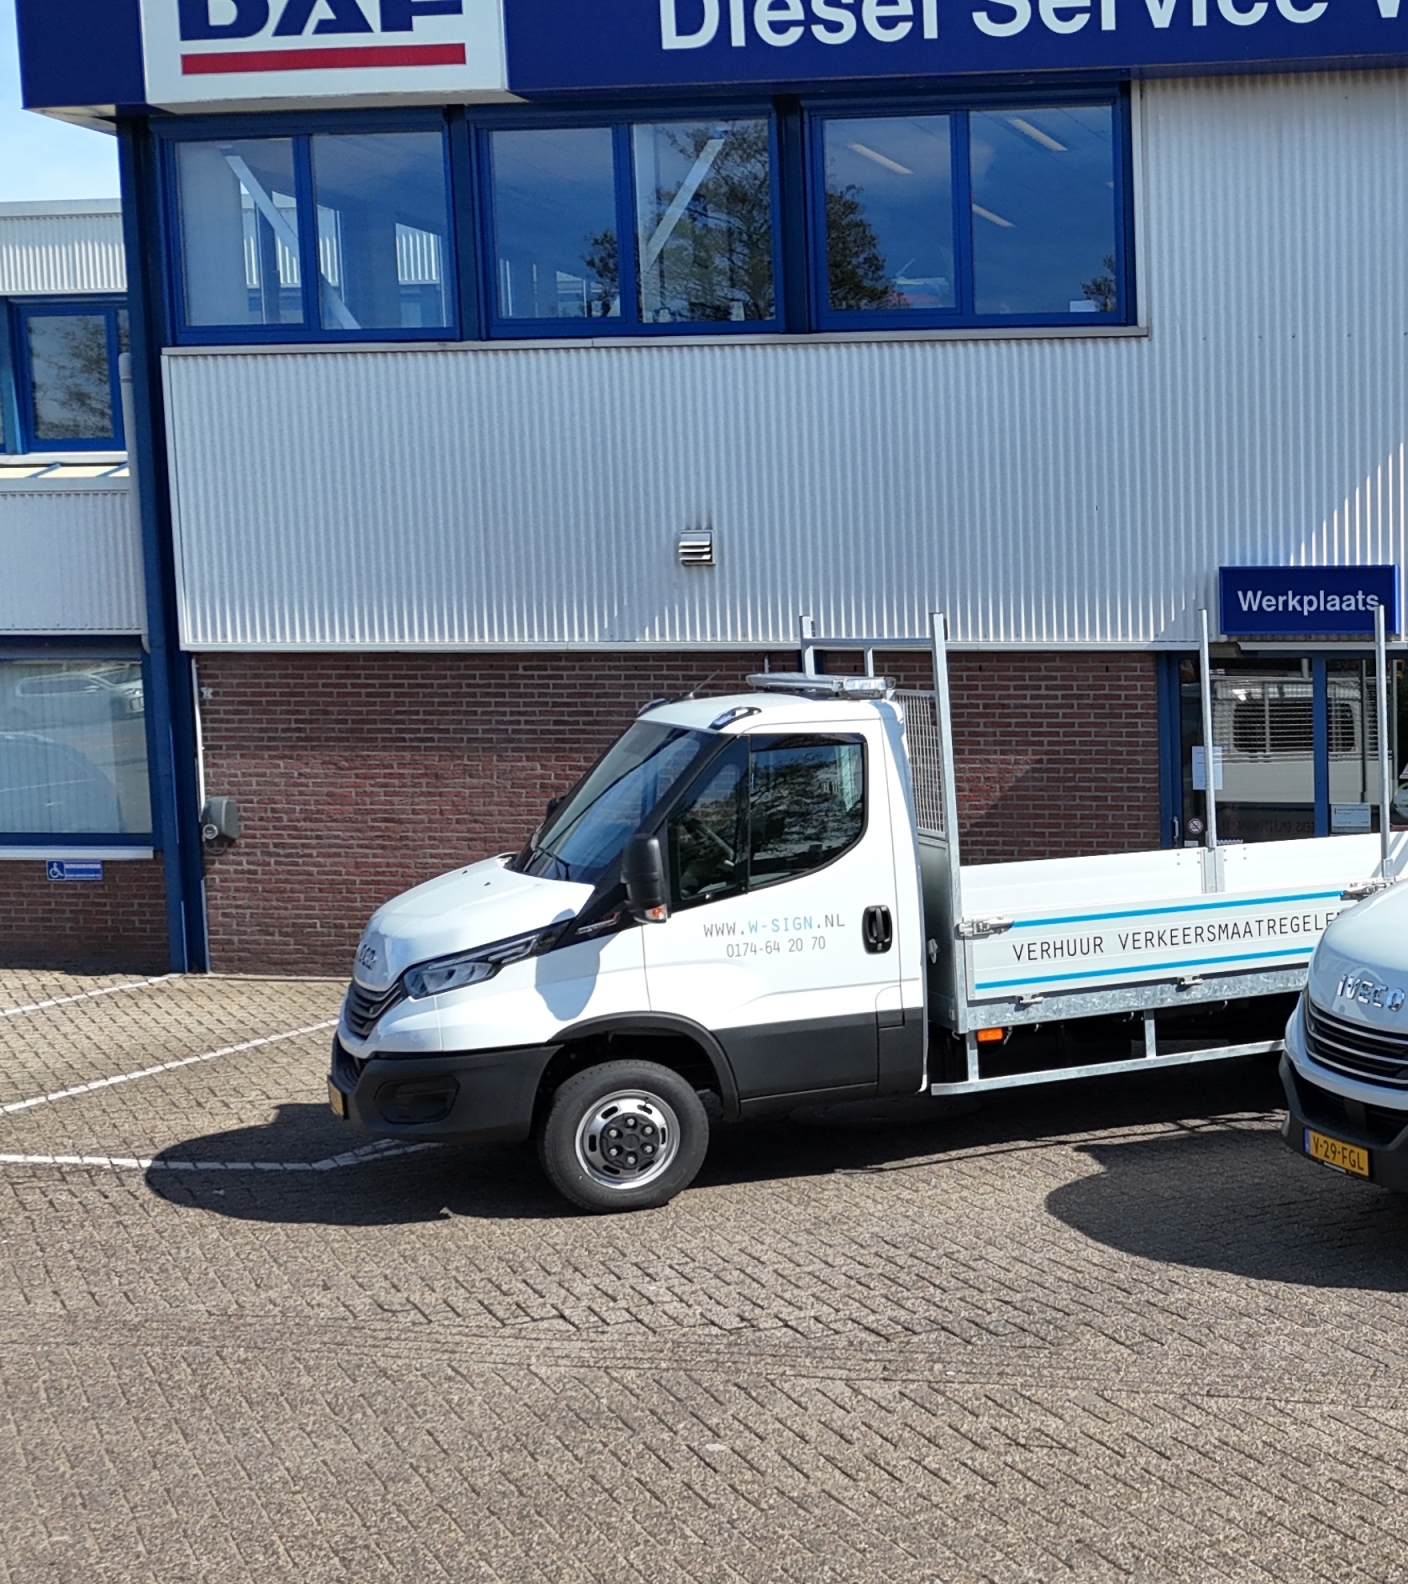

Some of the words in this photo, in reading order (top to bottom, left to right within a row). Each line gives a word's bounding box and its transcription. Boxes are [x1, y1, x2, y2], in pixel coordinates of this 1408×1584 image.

[660, 0, 939, 50] Diesel
[1236, 589, 1380, 616] Werkplaats
[703, 913, 846, 939] WWW.W-SIGN.NL
[1012, 935, 1105, 962] VERHUUR
[1118, 911, 1341, 951] VERKEERSMAATREGELE
[726, 940, 780, 958] 0174-64
[788, 937, 804, 953] 20
[811, 935, 826, 950] 70
[1336, 973, 1406, 1013] IVECO
[1312, 1135, 1365, 1172] V-29-FGL
